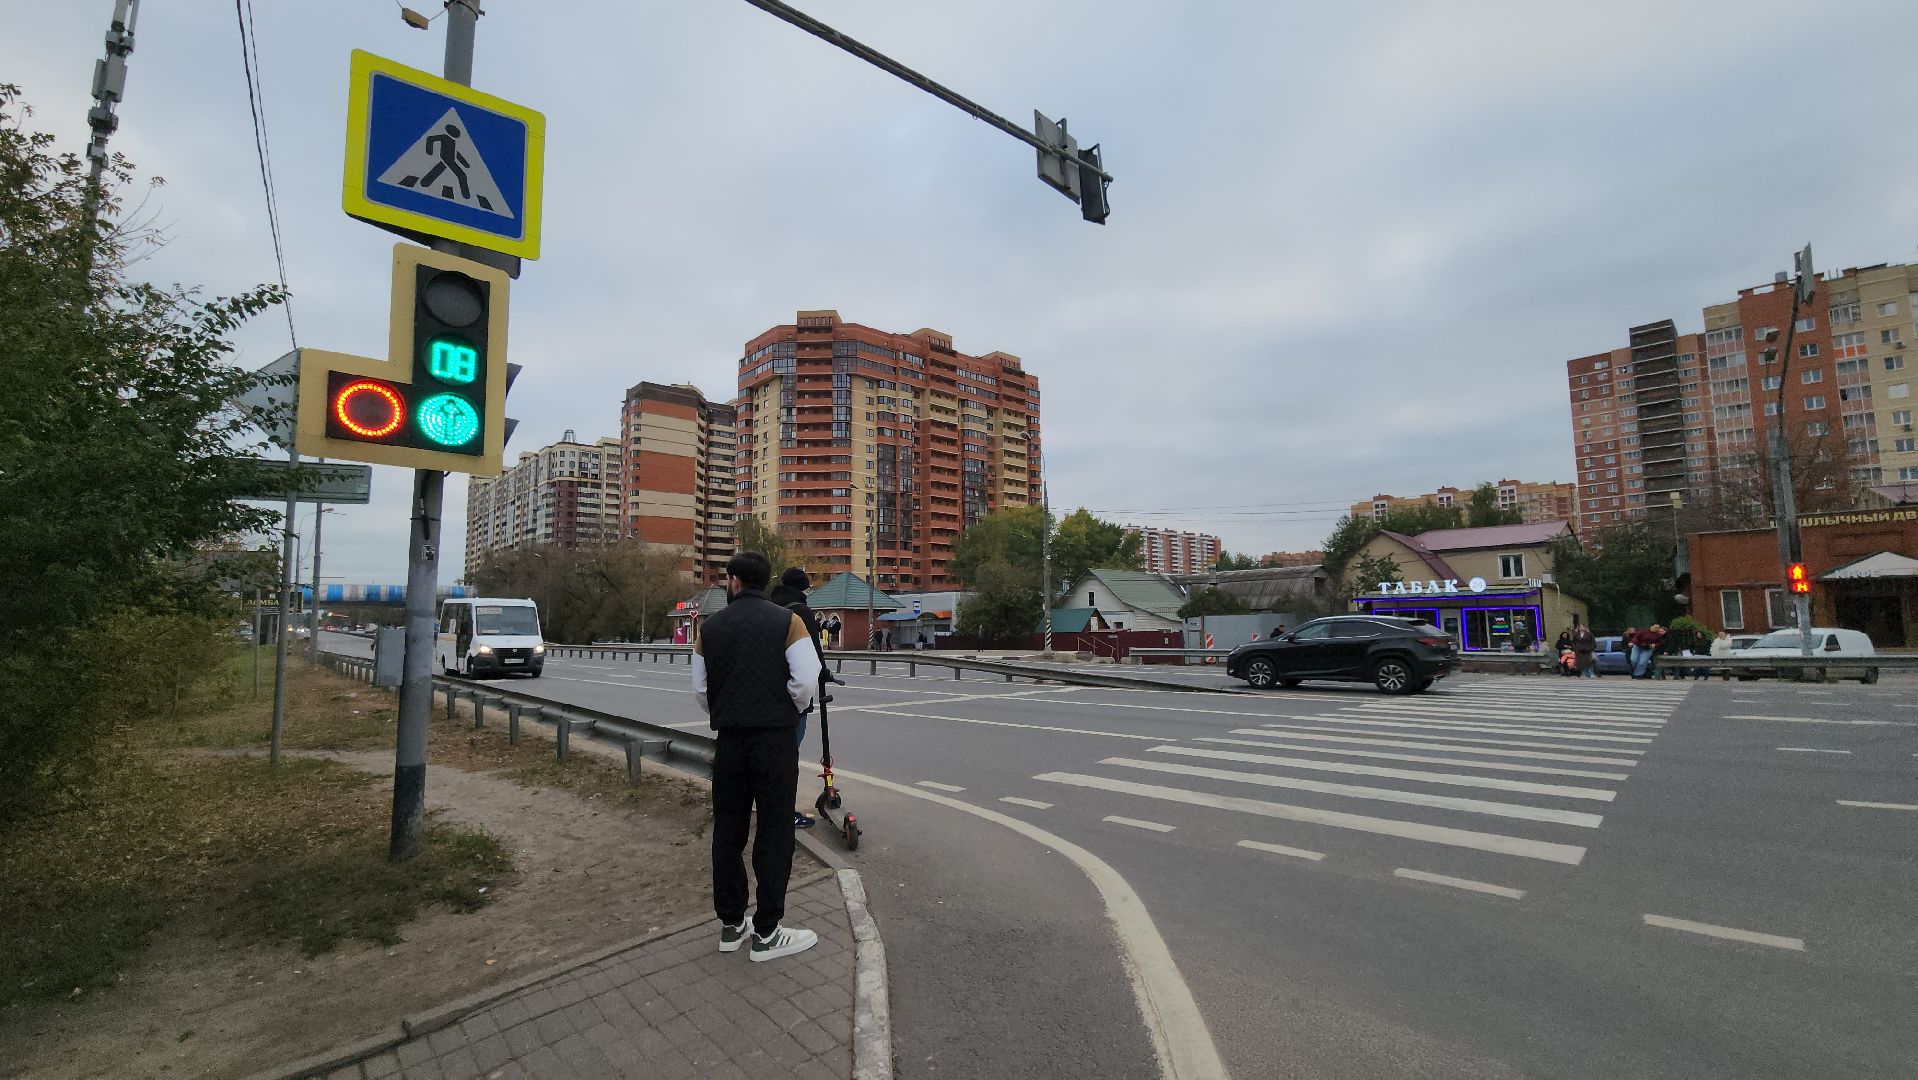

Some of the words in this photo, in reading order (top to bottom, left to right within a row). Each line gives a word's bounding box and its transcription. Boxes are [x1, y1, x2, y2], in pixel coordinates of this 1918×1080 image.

[430, 341, 477, 384] 08
[1769, 512, 1890, 529] ШШЛЫЧНЫЙ
[1378, 579, 1459, 595] ТАБАК
